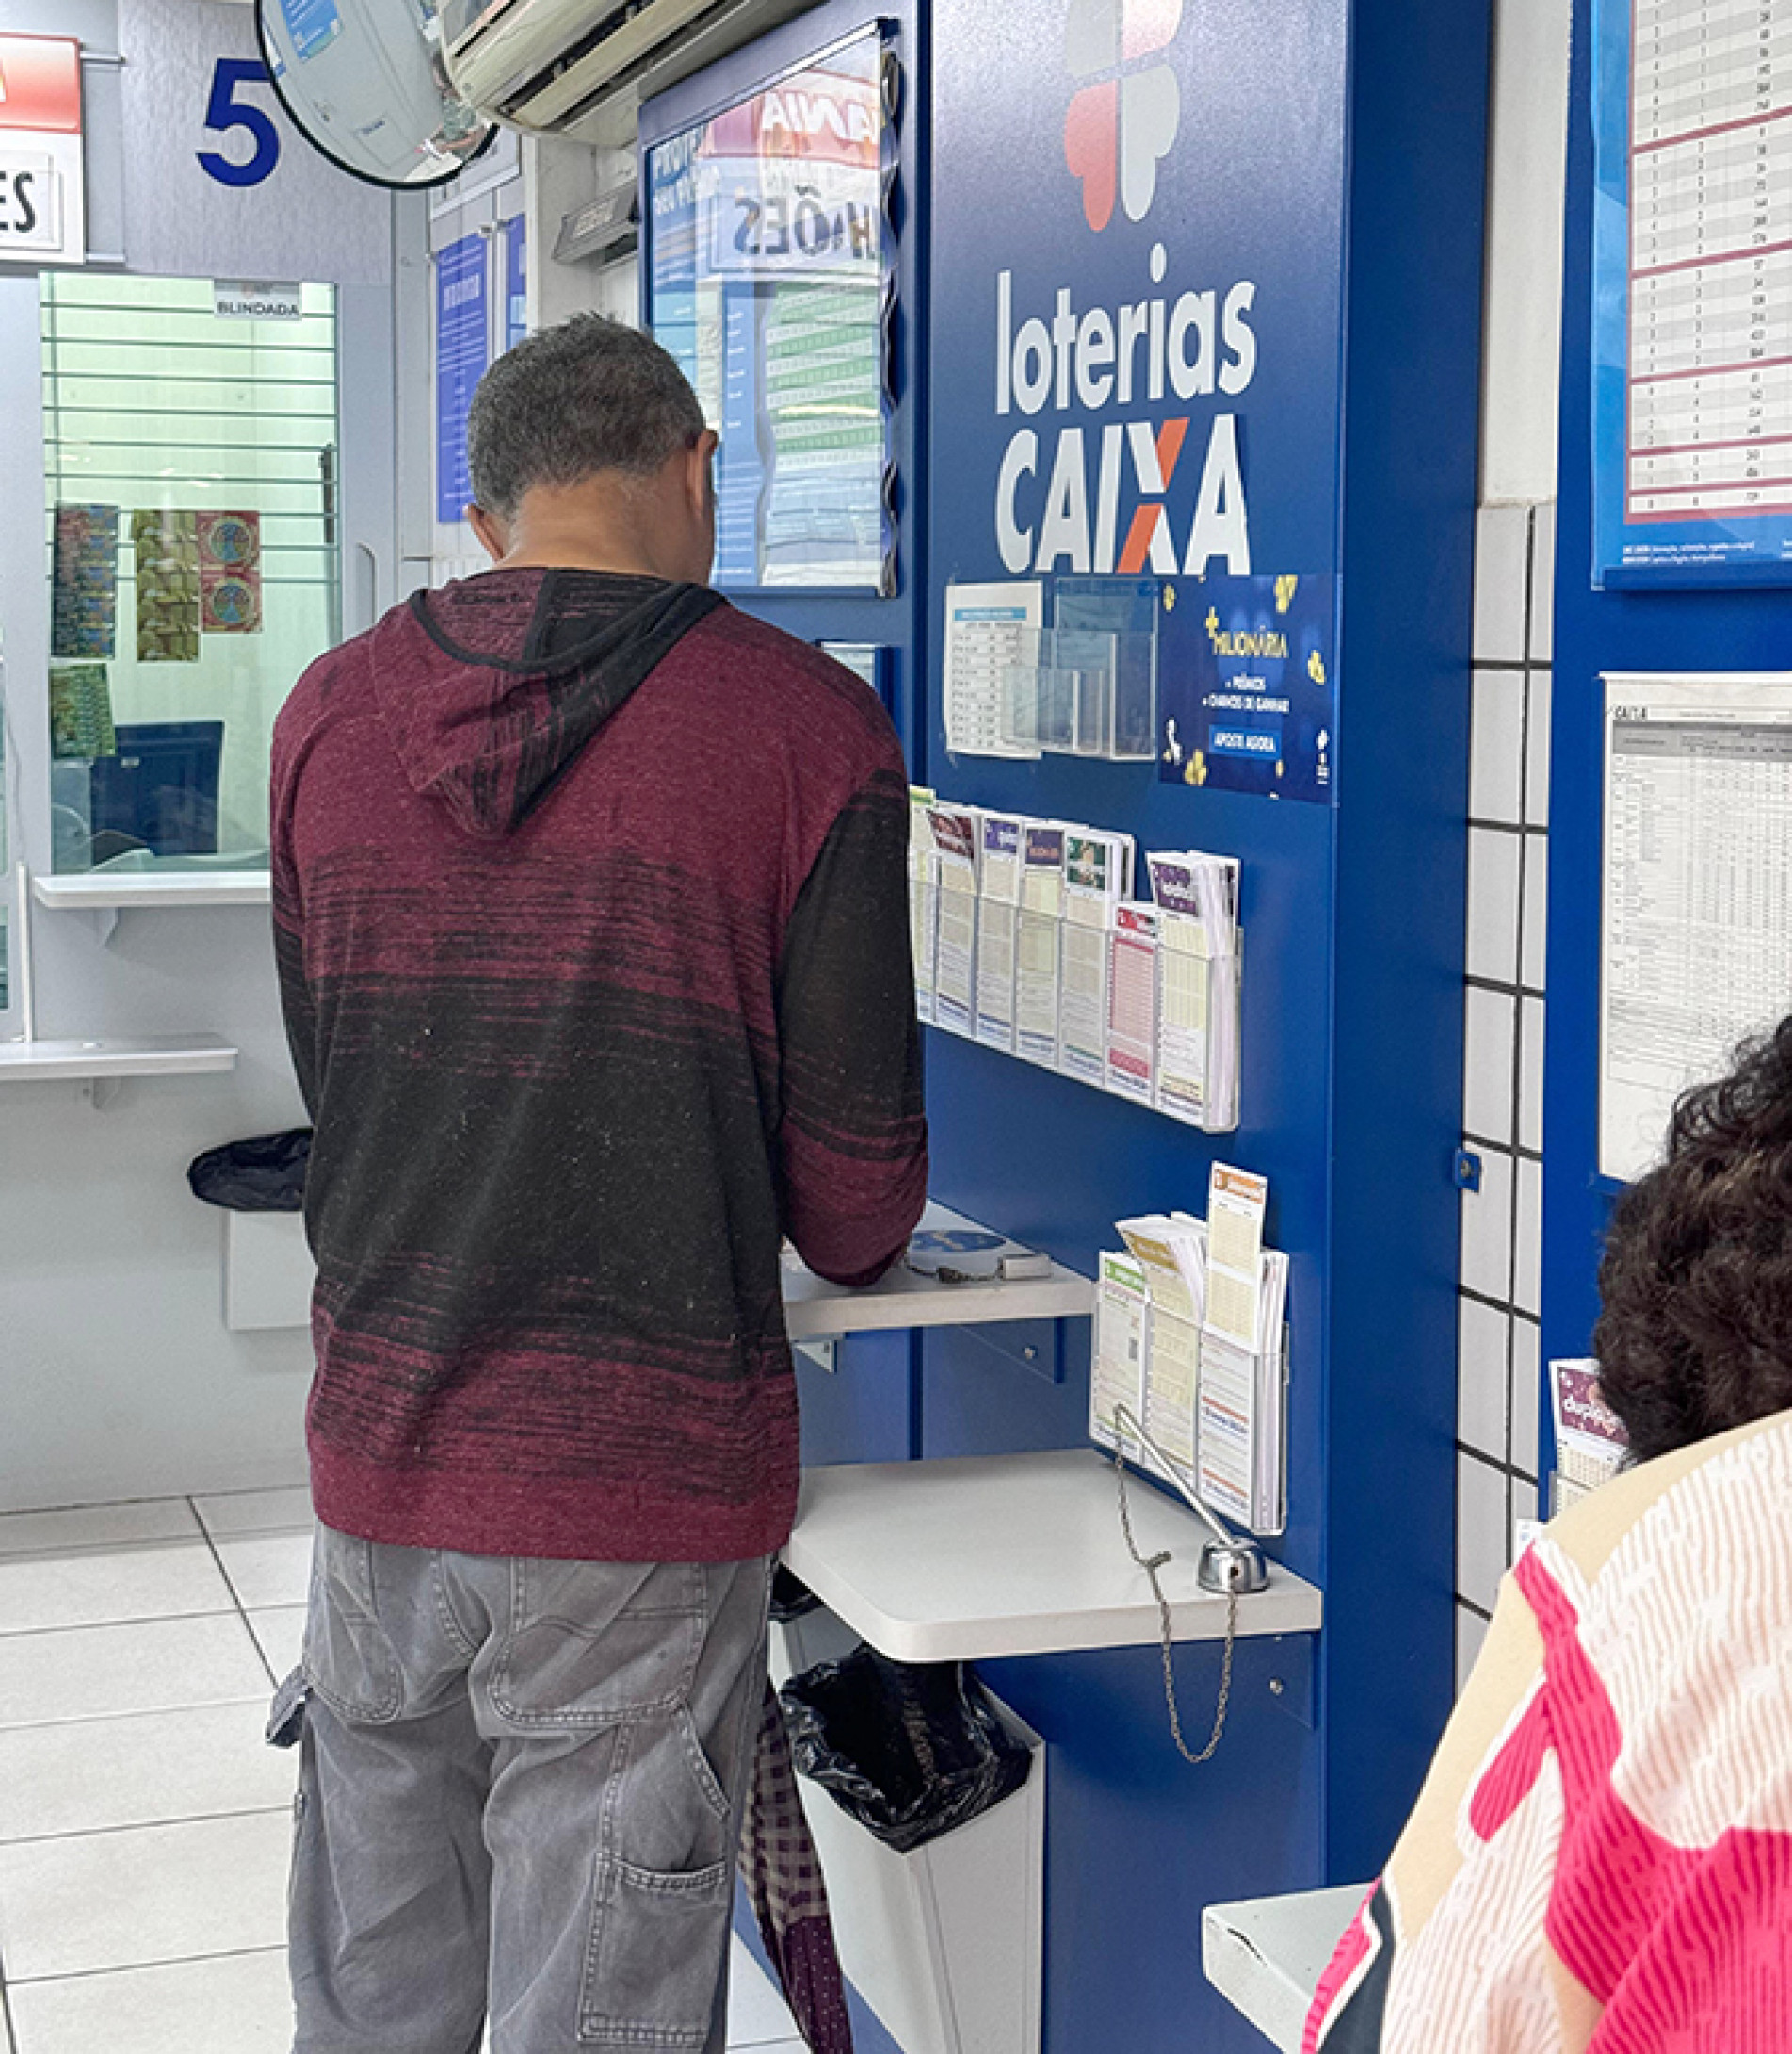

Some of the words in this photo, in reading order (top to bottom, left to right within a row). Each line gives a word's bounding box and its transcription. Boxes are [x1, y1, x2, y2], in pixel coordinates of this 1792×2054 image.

[195, 57, 281, 187] 5
[217, 301, 299, 316] BLINDADA
[995, 242, 1256, 414] loterias
[996, 413, 1251, 576] CAIXA
